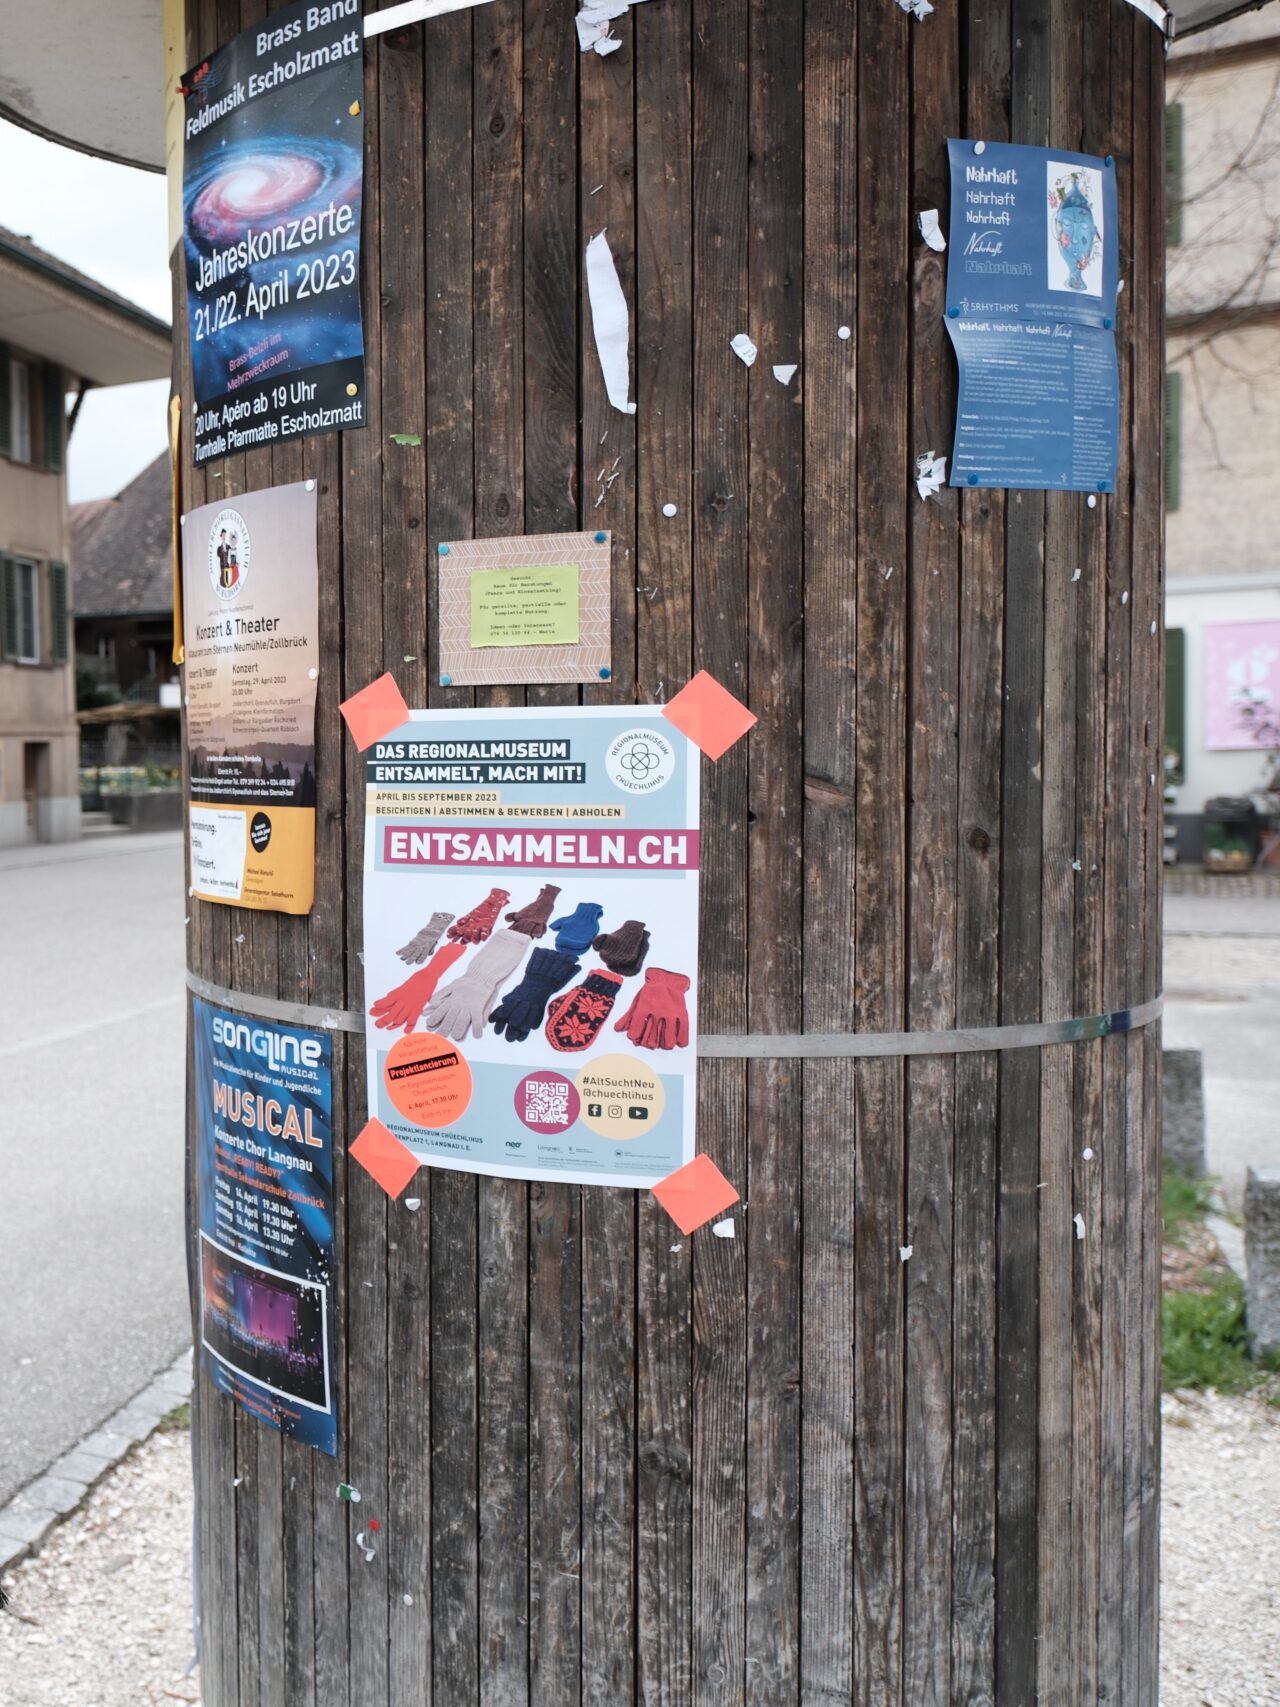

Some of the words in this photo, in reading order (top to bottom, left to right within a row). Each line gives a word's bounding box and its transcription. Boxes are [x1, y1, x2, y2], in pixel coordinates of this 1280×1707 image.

[256, 19, 301, 56] Brass
[307, 0, 358, 32] Band
[186, 82, 246, 140] Feldmusik
[248, 31, 359, 98] Escholzmatt
[966, 166, 1018, 185] Nahrhaft
[966, 190, 1016, 206] Nahrhaft
[966, 210, 1011, 226] Nahrhaft
[195, 201, 353, 292] Jahreskonzerte
[963, 230, 1003, 257] Nahrhaft
[965, 260, 1033, 276] Nahrhaft
[195, 290, 241, 341] 21./22.
[246, 269, 289, 320] April
[296, 249, 356, 300] 2023
[971, 302, 1019, 313] 5RHYTHMS
[269, 332, 282, 347] im
[958, 322, 991, 333] Nahrhaft
[992, 323, 1023, 334] Nahrhaft
[1025, 325, 1051, 336] Nahrhaft
[227, 349, 289, 392] Mehrzweckraum
[195, 416, 205, 437] 20
[205, 409, 221, 432] Uhr,
[222, 400, 251, 427] Apéro
[253, 392, 268, 416] ab
[271, 386, 287, 409] 19
[290, 380, 317, 404] Uhr
[195, 435, 226, 461] Turnhalle
[227, 421, 278, 450] Pfarrmatte
[281, 400, 362, 435] Escholzmatt
[195, 623, 223, 641] Konzert
[224, 619, 233, 636] &
[234, 617, 280, 635] Theater
[233, 635, 308, 653] Neumühle/Zollbrück
[232, 663, 258, 674] Konzert
[261, 676, 273, 686] April
[376, 743, 405, 760] DAS
[408, 741, 567, 759] REGIONALMUSEUM
[611, 732, 669, 757] REGIONALMUSEUM
[375, 766, 485, 783] ENTSAMMELT,
[488, 766, 539, 781] MACH
[542, 765, 583, 781] MIT!
[376, 792, 400, 801] APRIL
[402, 792, 416, 801] BIS
[418, 792, 473, 801] SEPTEMBER
[475, 792, 497, 802] 2023
[376, 806, 431, 816] BESICHTIGEN
[439, 807, 496, 816] ABSTIMMEN
[498, 807, 505, 816] &
[507, 807, 563, 817] BEWERBEN
[572, 808, 621, 817] ABHOLEN
[390, 831, 687, 864] ENTSAMMELN.CH
[390, 1056, 457, 1080] Projektlancierung
[254, 1072, 272, 1085] Kinder
[272, 1078, 283, 1087] und
[283, 1079, 322, 1096] Jugendliche
[582, 1076, 655, 1089] #AltSuchtNeu
[447, 1093, 459, 1101] Uhr
[582, 1088, 654, 1101] @chuechlihus
[213, 1078, 323, 1149] MUSICAL
[386, 1123, 440, 1137] REGIONALMUSEUM
[214, 1124, 246, 1150] Konzerte
[245, 1137, 267, 1158] Chor
[268, 1146, 313, 1173] Langnau
[430, 1139, 460, 1150] LANGNAU
[238, 1171, 287, 1198] Sekundarschule
[287, 1189, 326, 1209] Zollbrück
[243, 1191, 259, 1206] April
[262, 1198, 280, 1214] 19.30
[280, 1204, 294, 1218] Uhr
[244, 1204, 259, 1219] April
[262, 1212, 280, 1227] 19.30
[244, 1218, 259, 1233] April
[262, 1225, 280, 1241] 13.30
